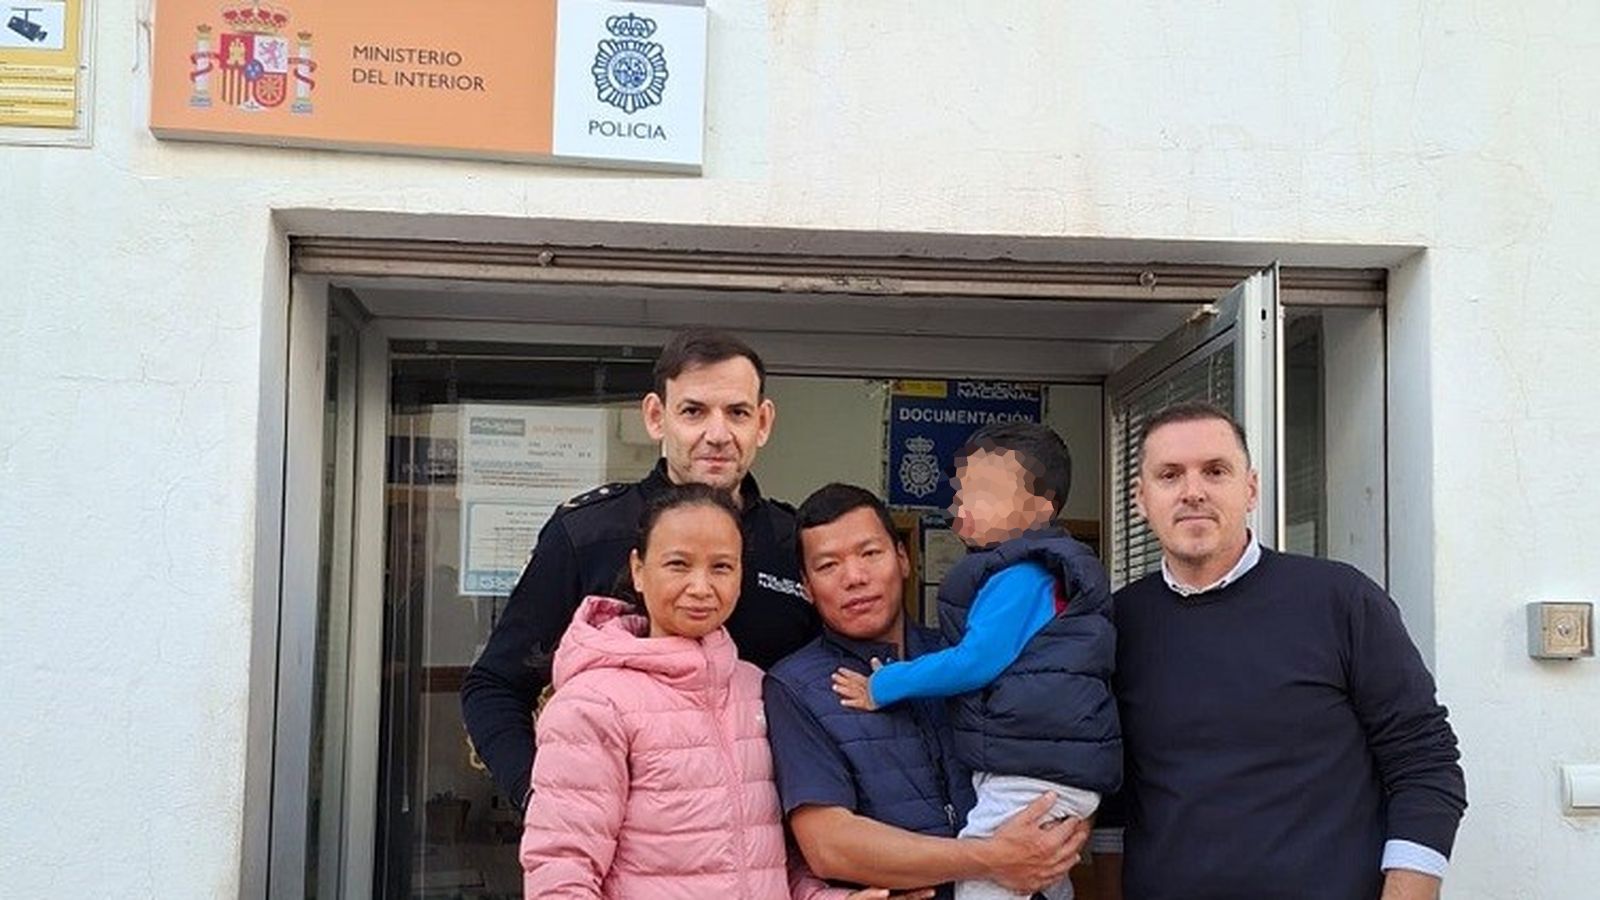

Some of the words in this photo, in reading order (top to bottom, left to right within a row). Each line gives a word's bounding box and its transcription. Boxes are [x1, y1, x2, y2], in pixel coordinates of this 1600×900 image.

[353, 45, 462, 67] MINISTERIO
[352, 68, 388, 85] DEL
[395, 71, 485, 91] INTERIOR
[588, 120, 667, 140] POLICIA
[957, 388, 1039, 402] NACIONAL
[899, 407, 1034, 424] DOCUMENTACIÓN
